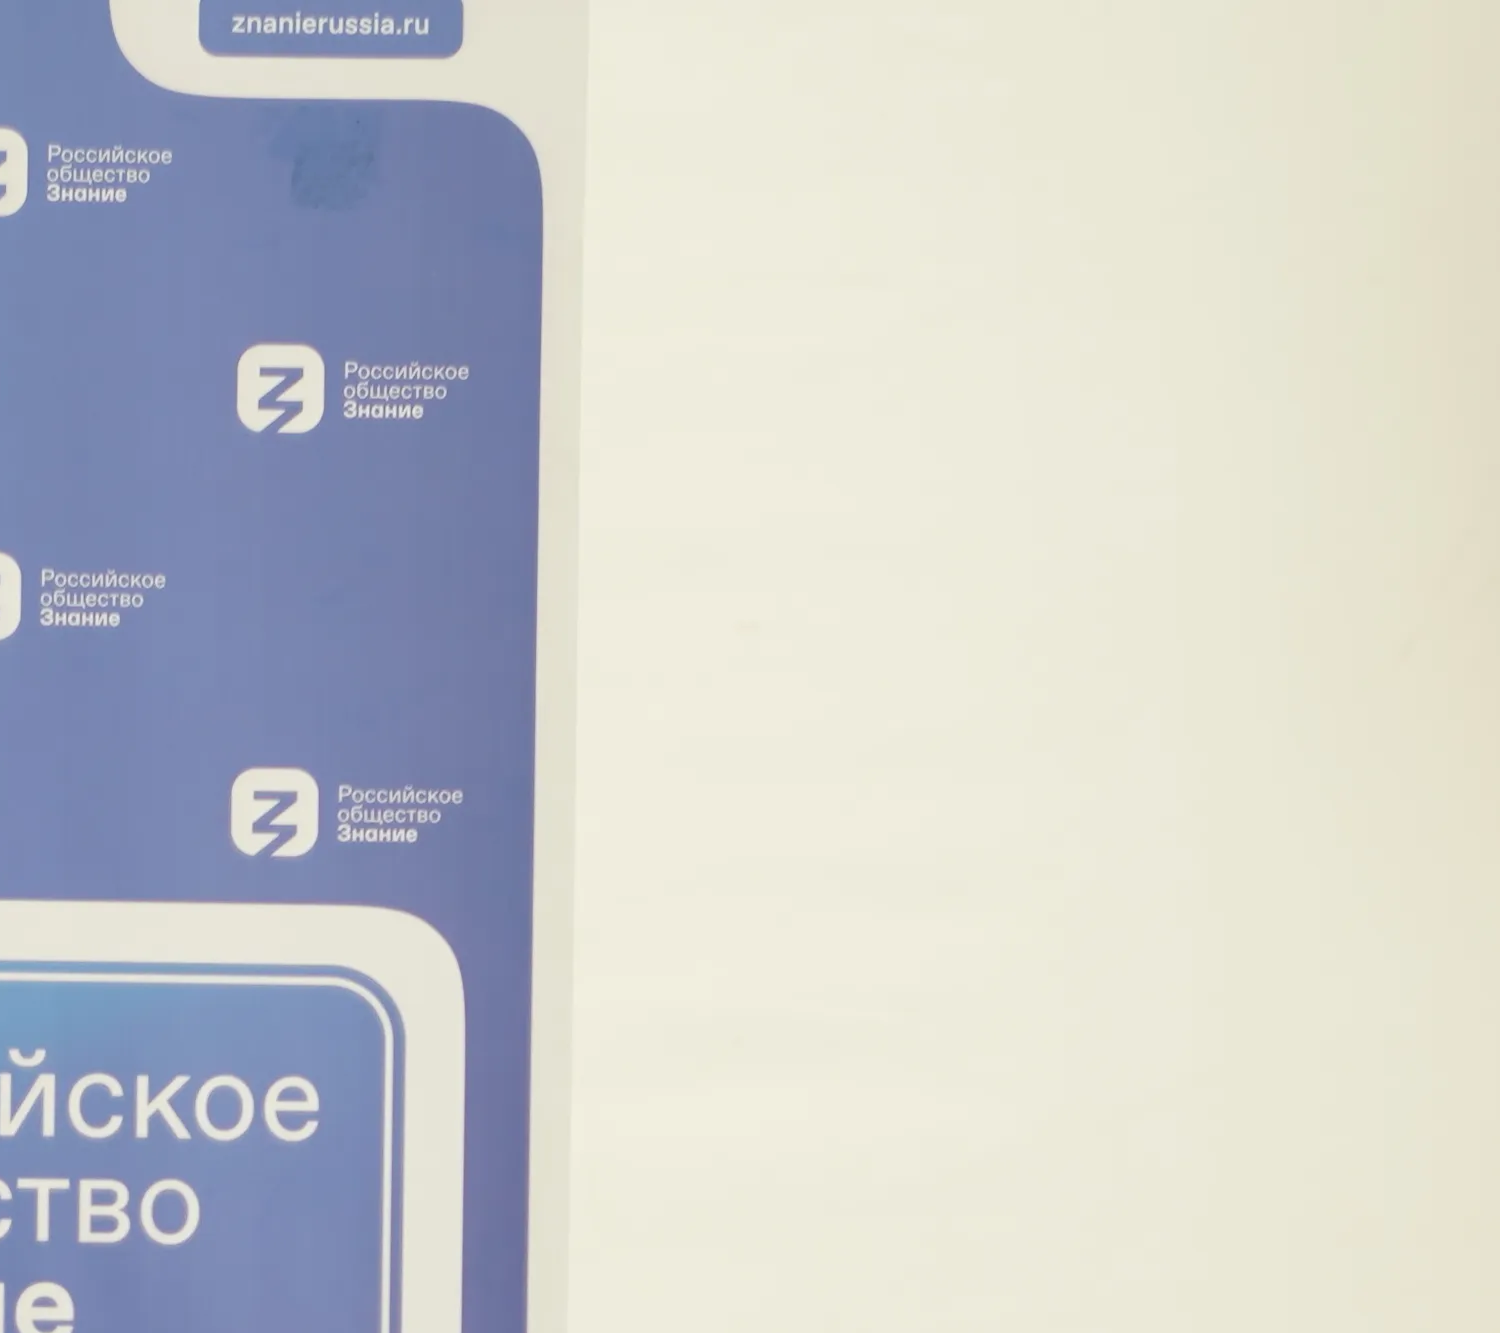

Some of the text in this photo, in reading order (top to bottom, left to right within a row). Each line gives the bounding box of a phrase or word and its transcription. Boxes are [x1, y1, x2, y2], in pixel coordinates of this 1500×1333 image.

[231, 12, 430, 35] znanierussia.ru
[47, 143, 173, 163] Российское
[46, 164, 151, 184] общество
[46, 182, 127, 201] Знание
[344, 360, 469, 380] Российское
[343, 381, 448, 401] общество
[343, 399, 424, 418] Знание
[41, 567, 166, 587] Российское
[40, 588, 144, 608] общество
[39, 606, 121, 625] Знание
[338, 784, 464, 804] Российское
[336, 805, 442, 825] общество
[336, 823, 418, 842] Знание
